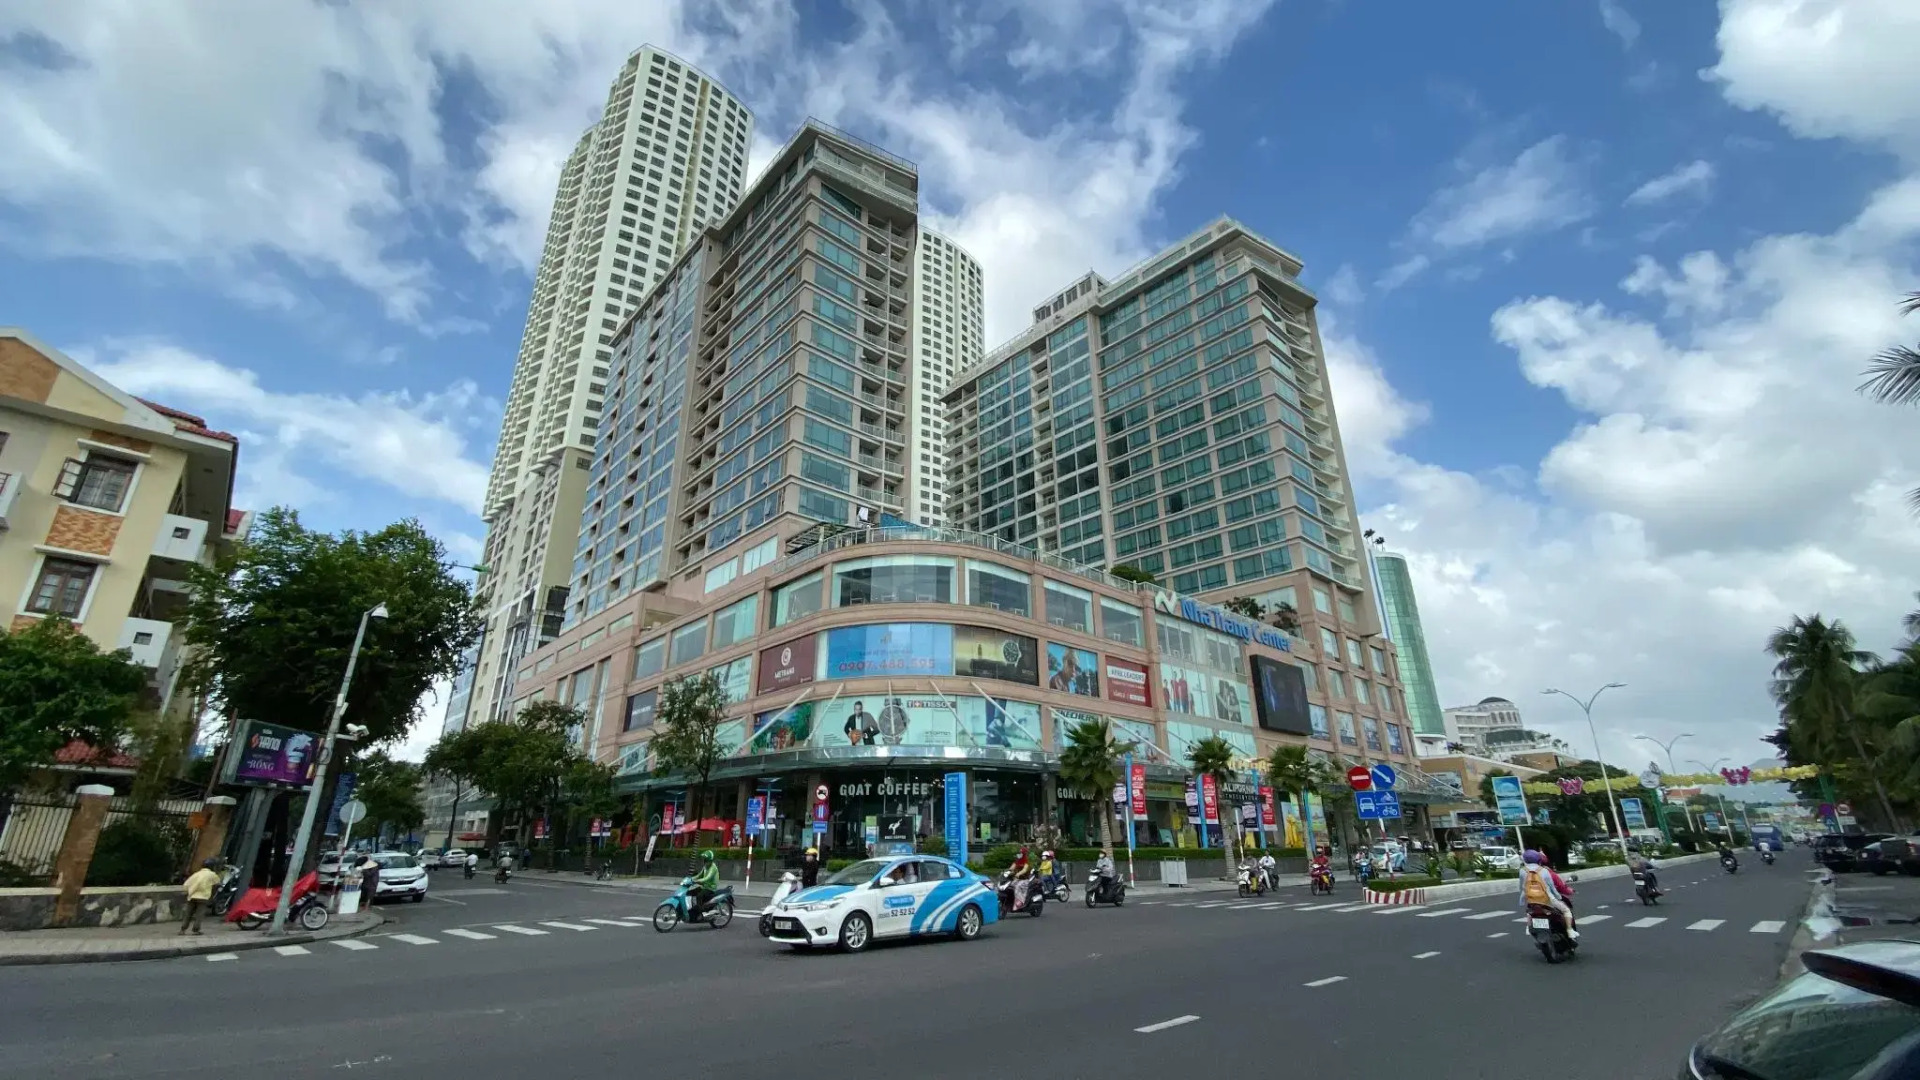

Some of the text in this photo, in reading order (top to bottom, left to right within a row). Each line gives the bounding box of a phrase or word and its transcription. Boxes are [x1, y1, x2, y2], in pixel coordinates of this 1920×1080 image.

[1181, 598, 1290, 652] Nha Trang Center
[839, 783, 928, 796] GOAT COFFEE
[891, 909, 898, 917] 52
[907, 907, 915, 915] 52
